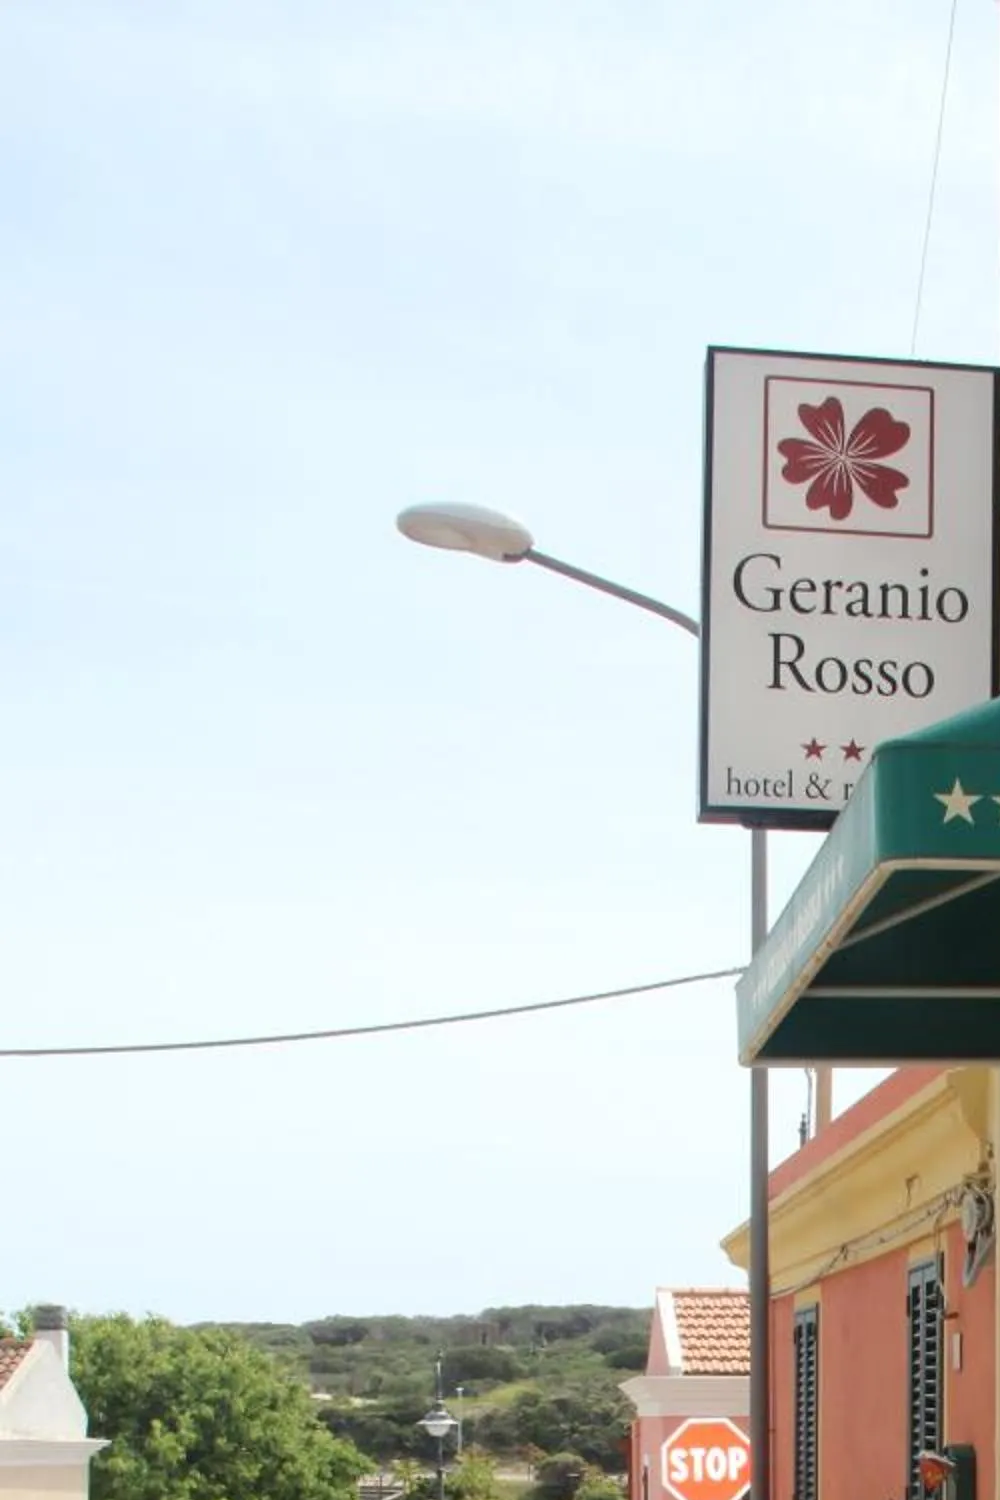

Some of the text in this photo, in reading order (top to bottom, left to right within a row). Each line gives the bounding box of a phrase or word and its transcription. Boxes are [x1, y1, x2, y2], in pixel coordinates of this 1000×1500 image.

[732, 553, 969, 625] Geranio
[768, 632, 935, 699] Rosso
[726, 767, 794, 799] hotel
[805, 773, 833, 801] &
[669, 1446, 748, 1482] STOP
